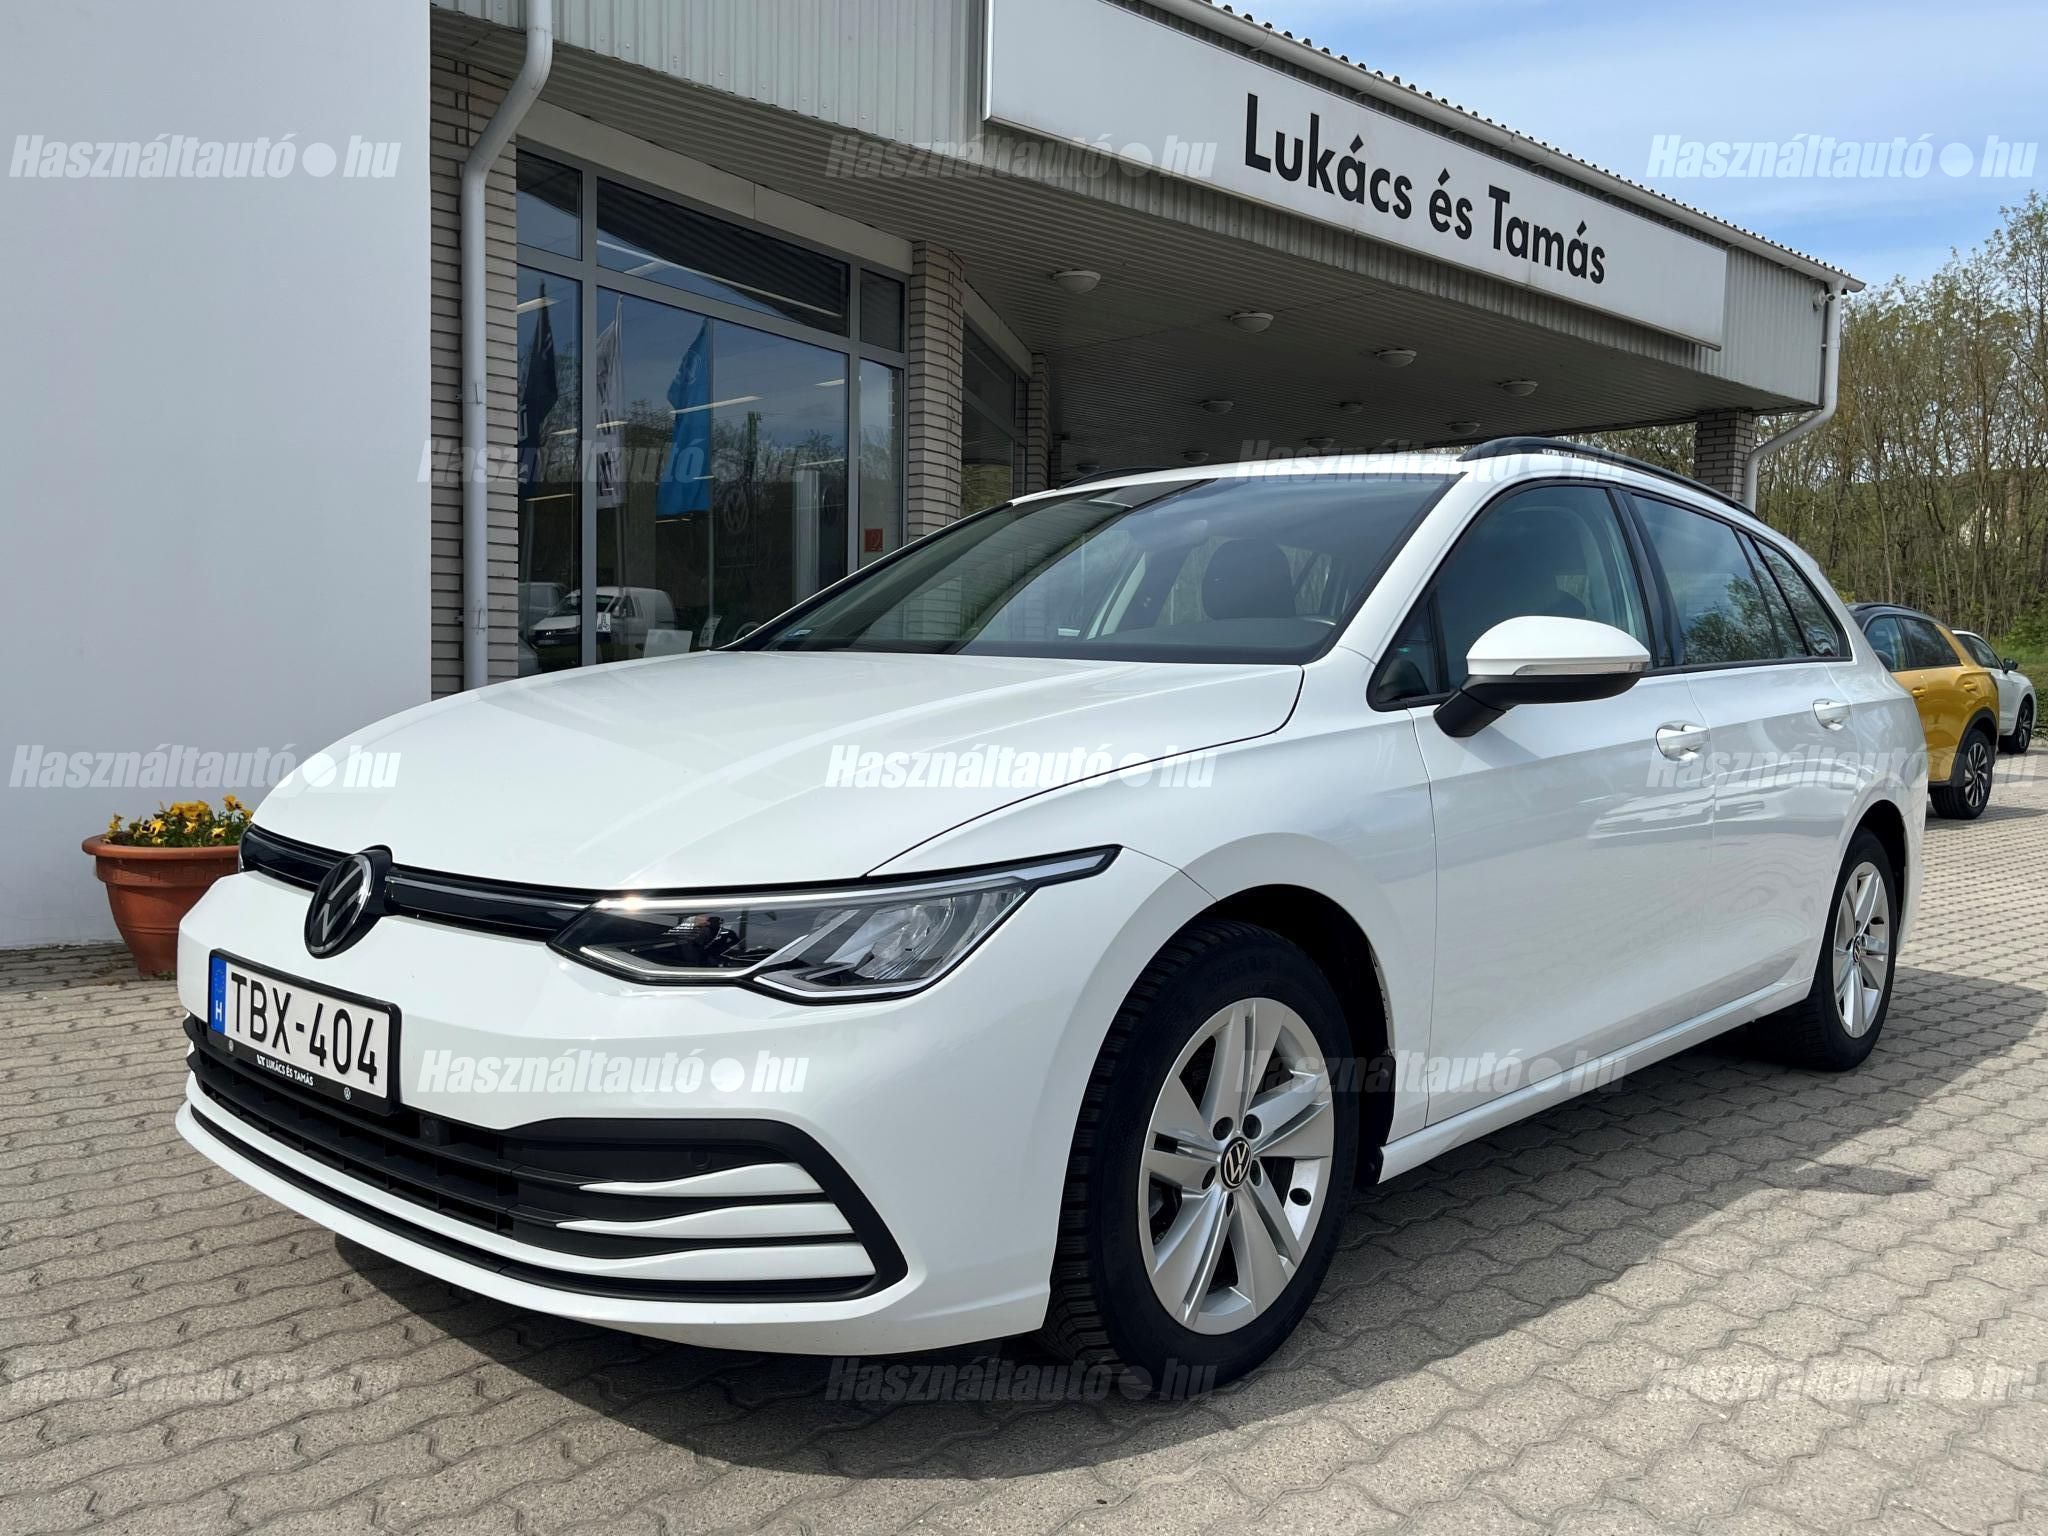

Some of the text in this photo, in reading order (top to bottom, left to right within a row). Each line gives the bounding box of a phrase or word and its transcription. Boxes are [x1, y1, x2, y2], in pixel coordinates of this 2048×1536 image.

[1245, 92, 1605, 284] Lukács és Tamás
[214, 1000, 223, 1022] H
[231, 971, 378, 1085] TBX-404
[265, 1059, 286, 1076] LUKÁCS
[286, 1064, 294, 1078] ÉS
[293, 1070, 314, 1086] TAMÁS
